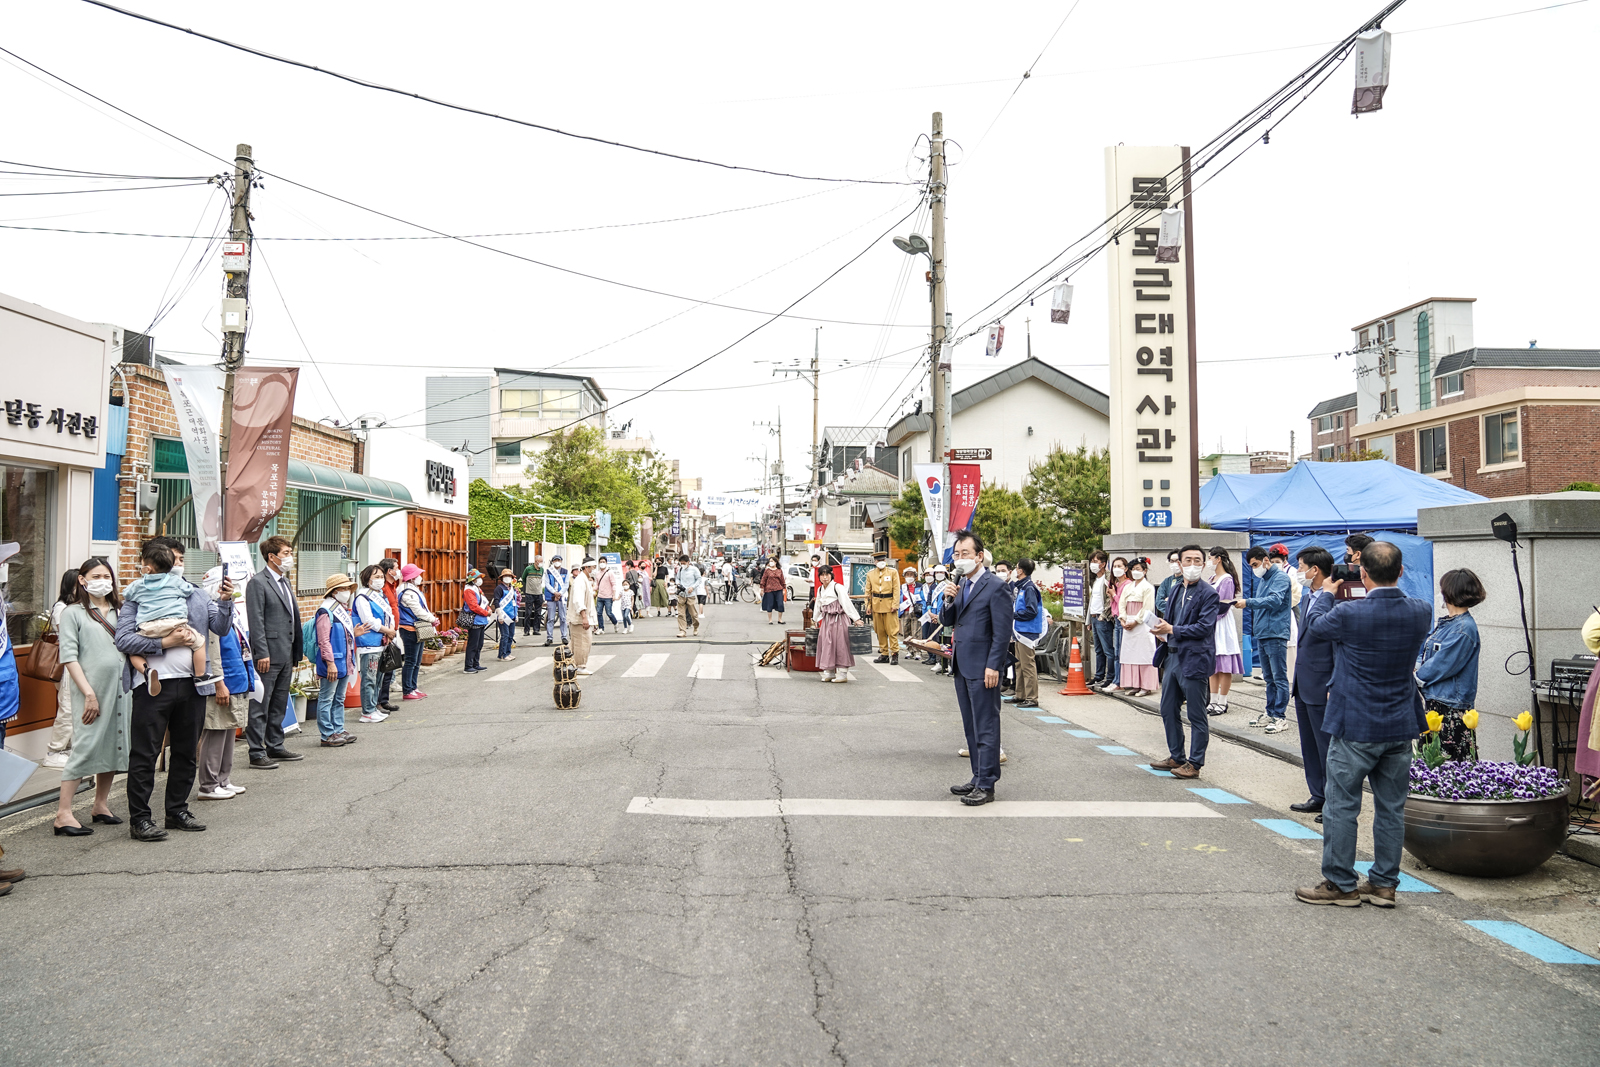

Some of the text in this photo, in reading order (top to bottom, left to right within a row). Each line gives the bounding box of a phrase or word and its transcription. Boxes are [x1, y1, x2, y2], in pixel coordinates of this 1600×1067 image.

[1131, 177, 1176, 463] 목포근대역사관
[0, 399, 99, 438] 달동 사진관
[196, 417, 210, 454] 문화공간
[268, 463, 279, 516] 목포근대역사
[1148, 511, 1167, 525] 2관
